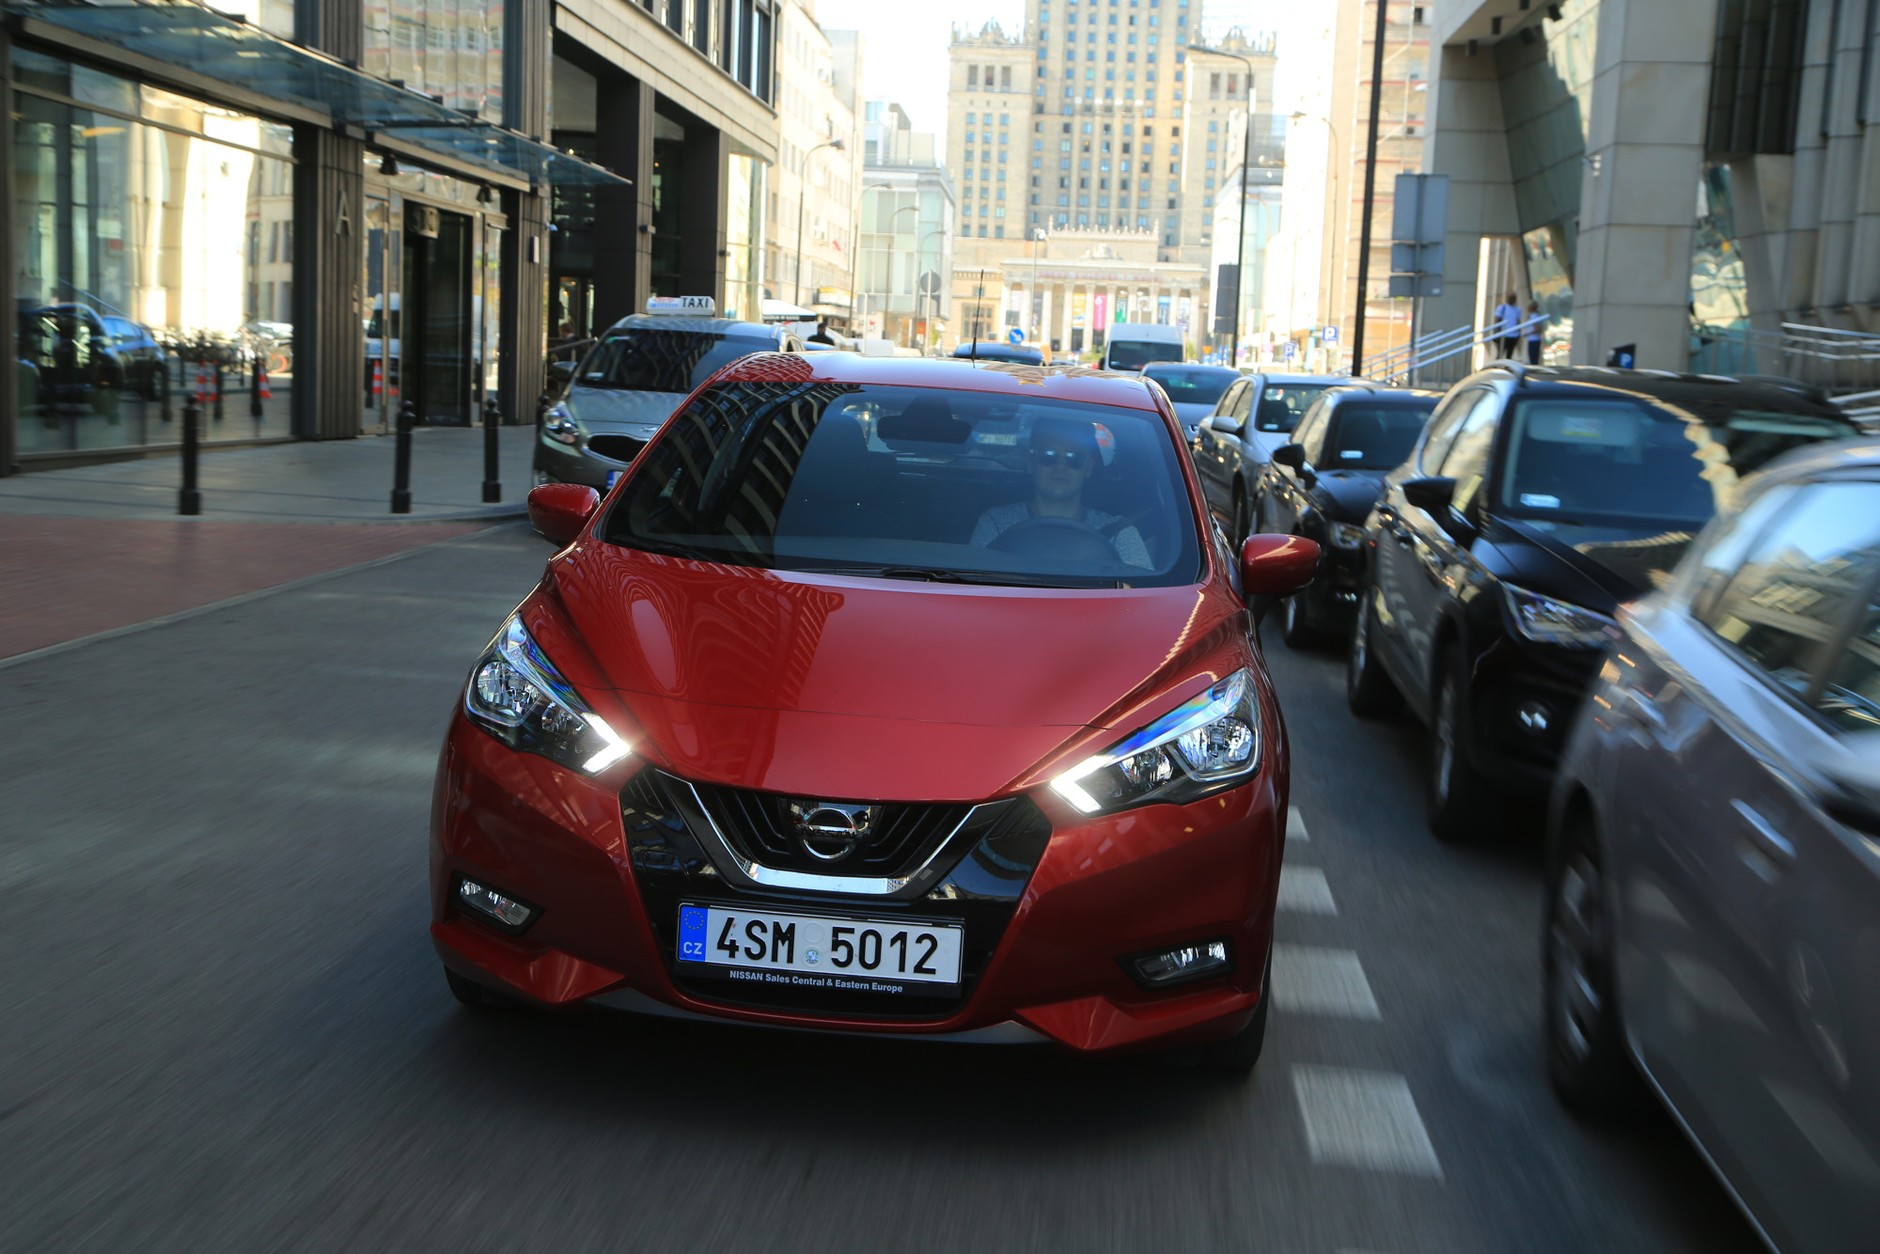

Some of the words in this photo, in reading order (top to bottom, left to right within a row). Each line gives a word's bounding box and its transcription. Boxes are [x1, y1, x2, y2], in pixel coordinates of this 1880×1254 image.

[682, 297, 709, 308] TAXI
[683, 941, 703, 955] CZ
[716, 916, 796, 964] 4SM
[830, 926, 938, 975] 5012
[729, 970, 764, 981] NISSAN
[765, 973, 790, 984] Sales
[791, 976, 825, 987] Central
[826, 979, 833, 987] &
[835, 980, 870, 990] Eastern
[872, 982, 903, 994] Europe
